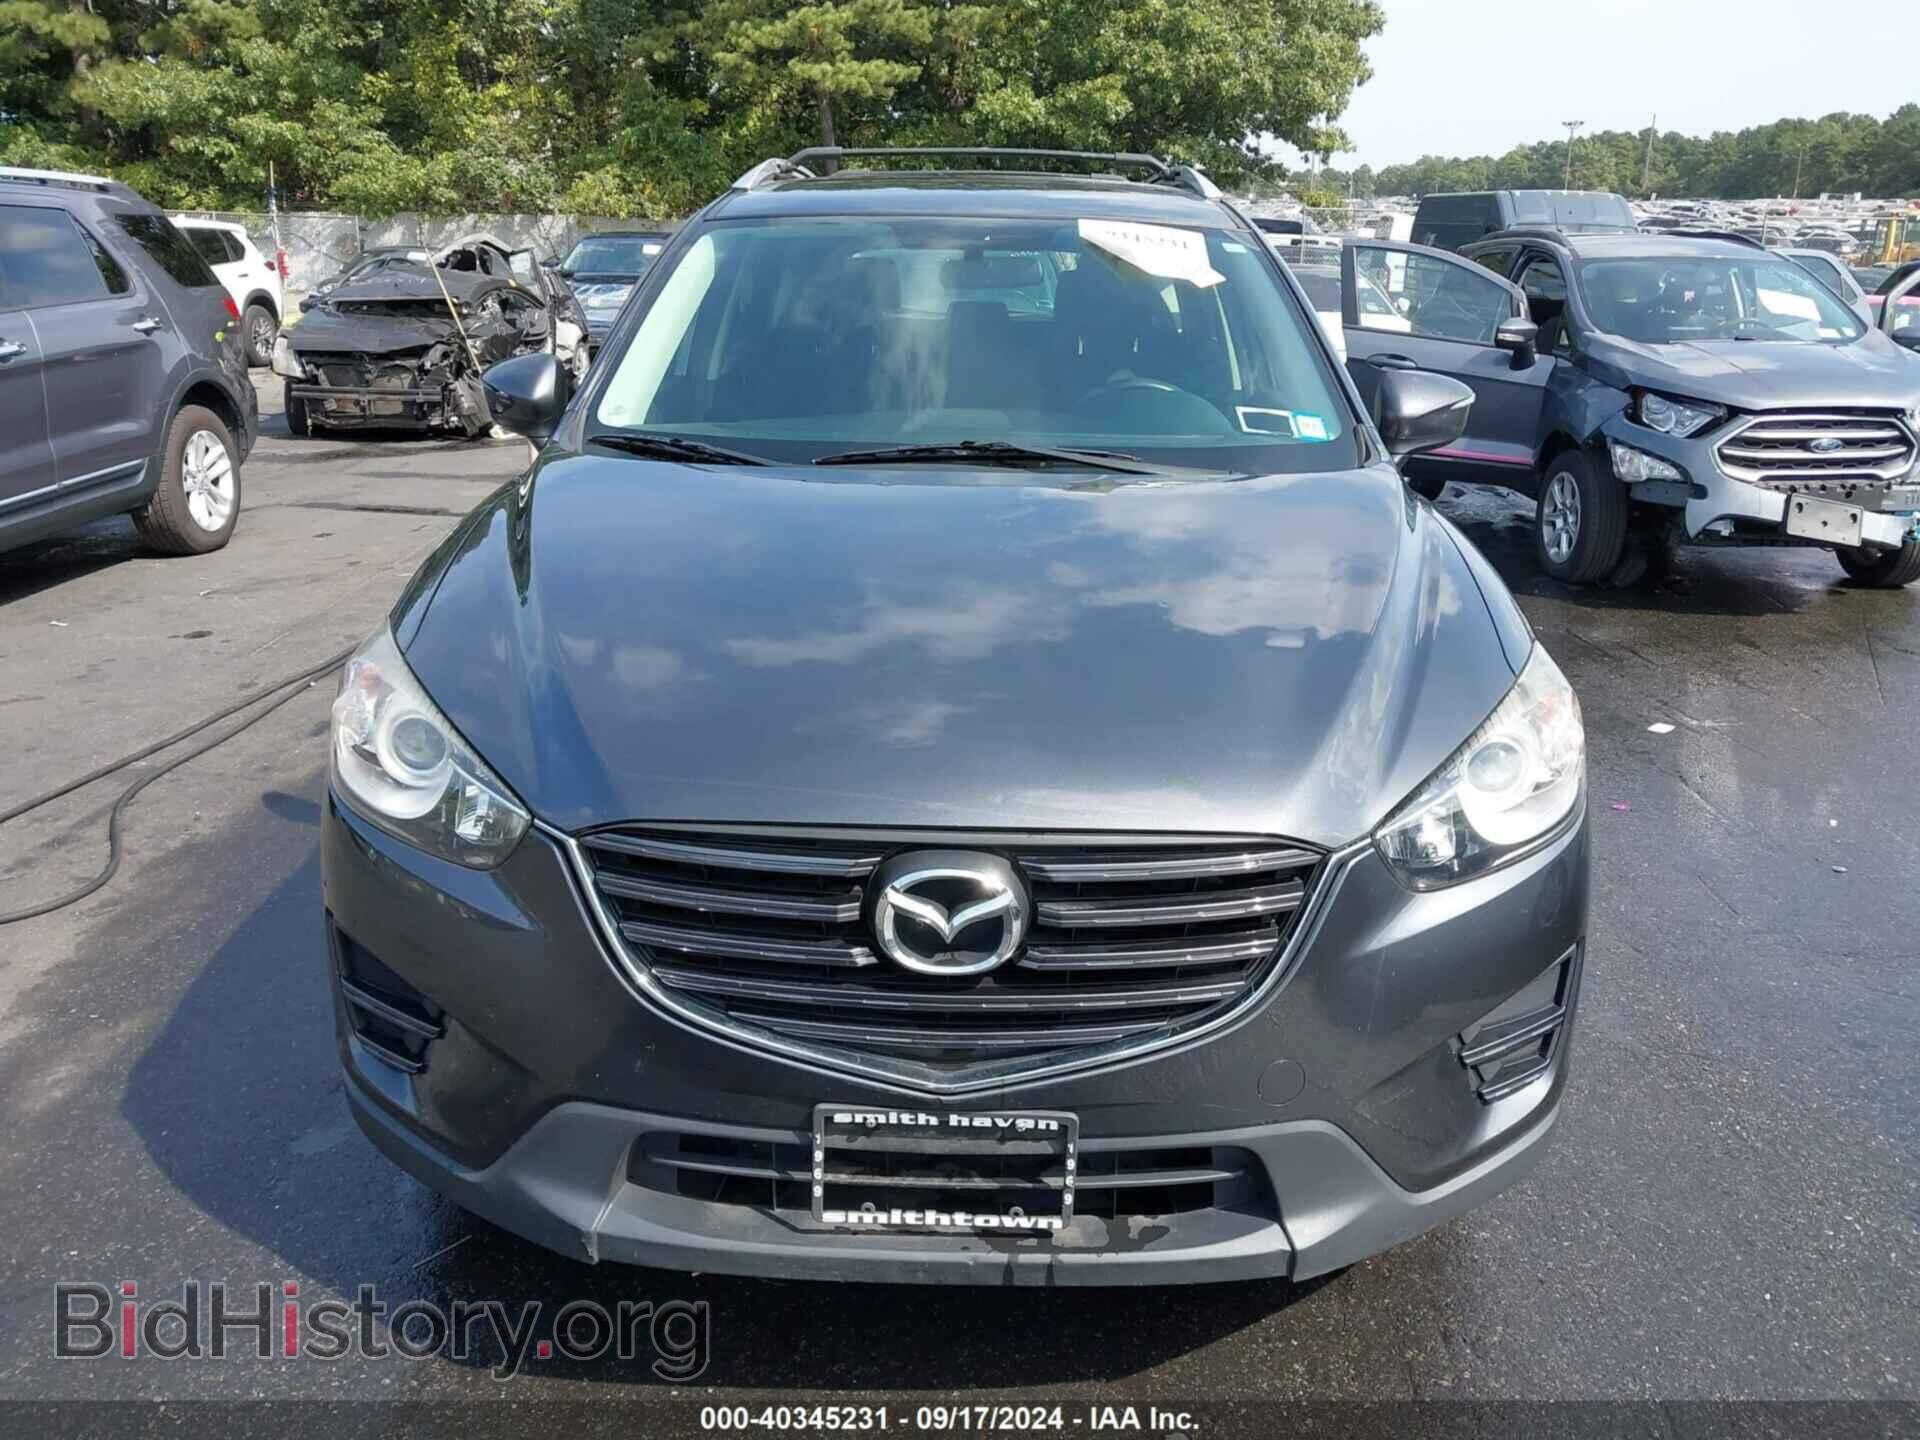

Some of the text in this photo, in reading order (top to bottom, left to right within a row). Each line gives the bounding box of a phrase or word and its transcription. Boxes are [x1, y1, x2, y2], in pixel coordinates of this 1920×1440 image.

[833, 1112, 1059, 1130] smith haven
[813, 1134, 824, 1197] 1969
[1064, 1143, 1076, 1205] 1969
[822, 1209, 1063, 1229] smithtown
